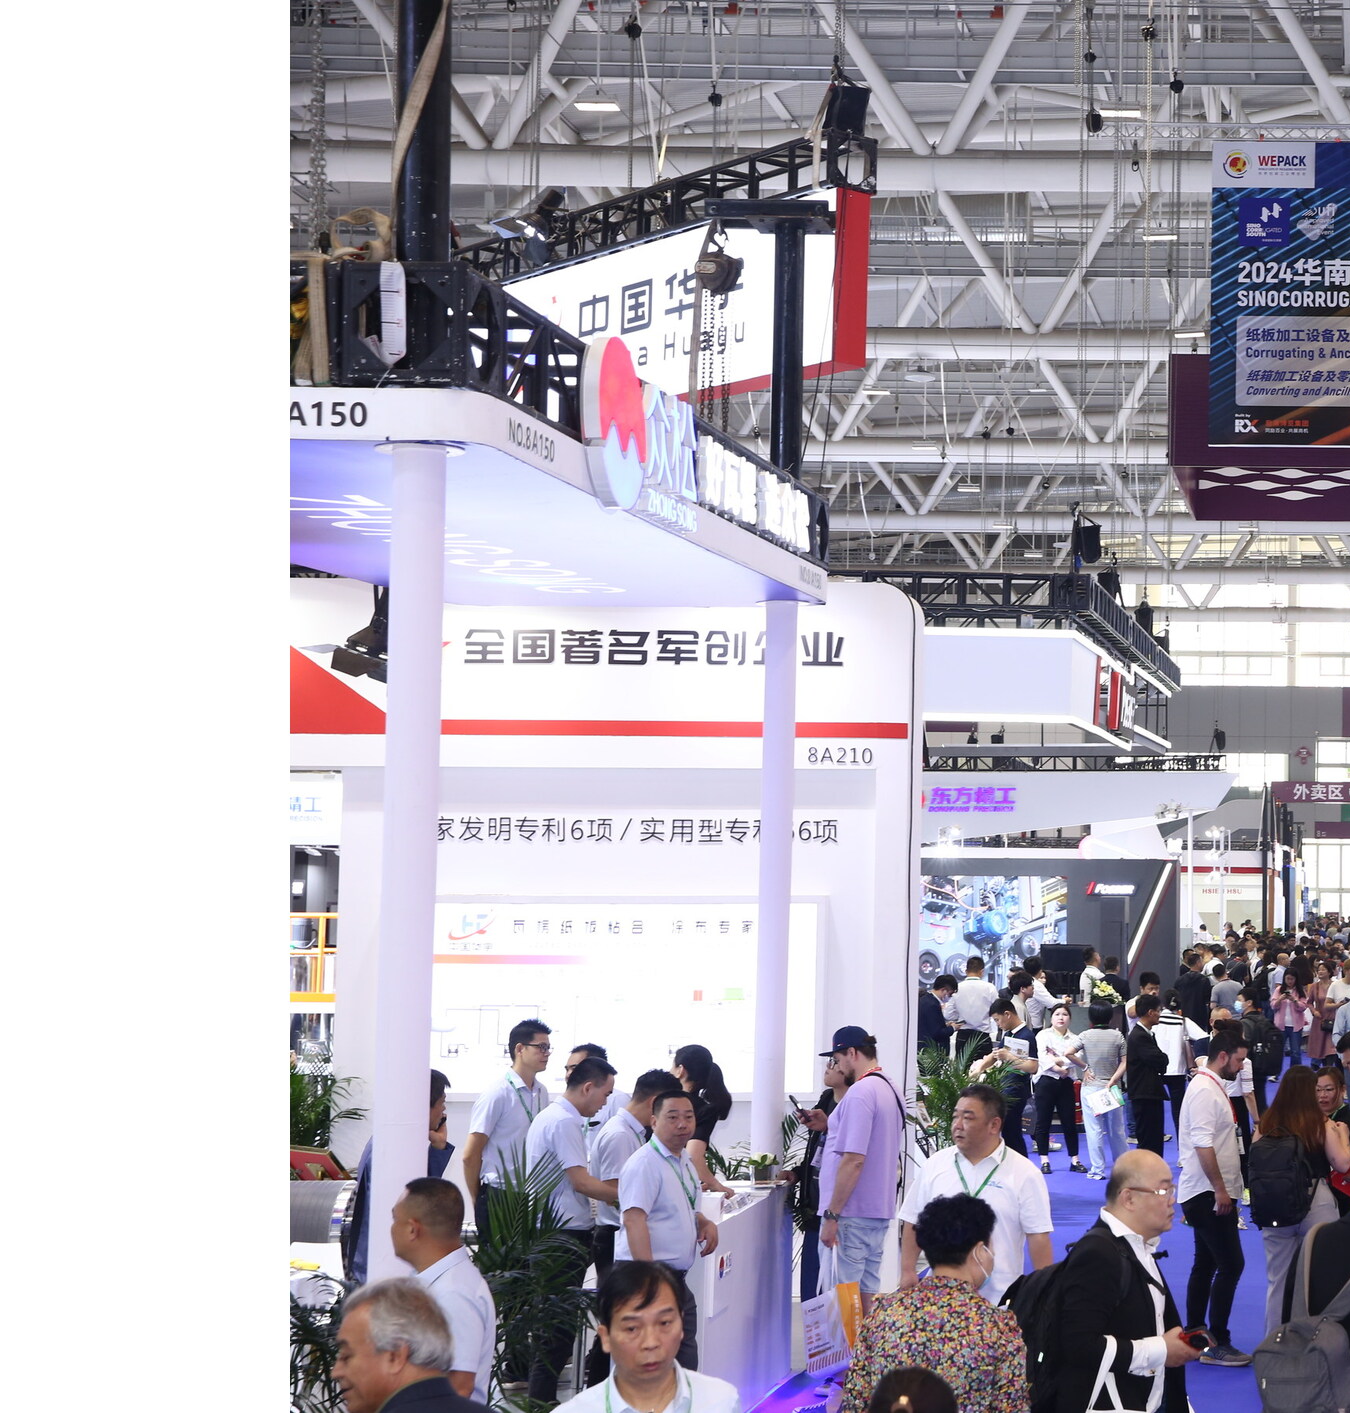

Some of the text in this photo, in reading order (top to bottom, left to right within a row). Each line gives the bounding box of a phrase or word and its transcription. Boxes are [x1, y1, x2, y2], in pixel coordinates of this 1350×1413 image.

[1258, 155, 1306, 167] WEPACK
[1246, 347, 1315, 361] Corrugating
[1318, 347, 1326, 359] &
[1246, 385, 1301, 397] Converting
[1302, 386, 1321, 396] and
[508, 417, 556, 463] NO.8A150
[807, 747, 874, 766] 8A210
[1293, 784, 1344, 800] 外卖区
